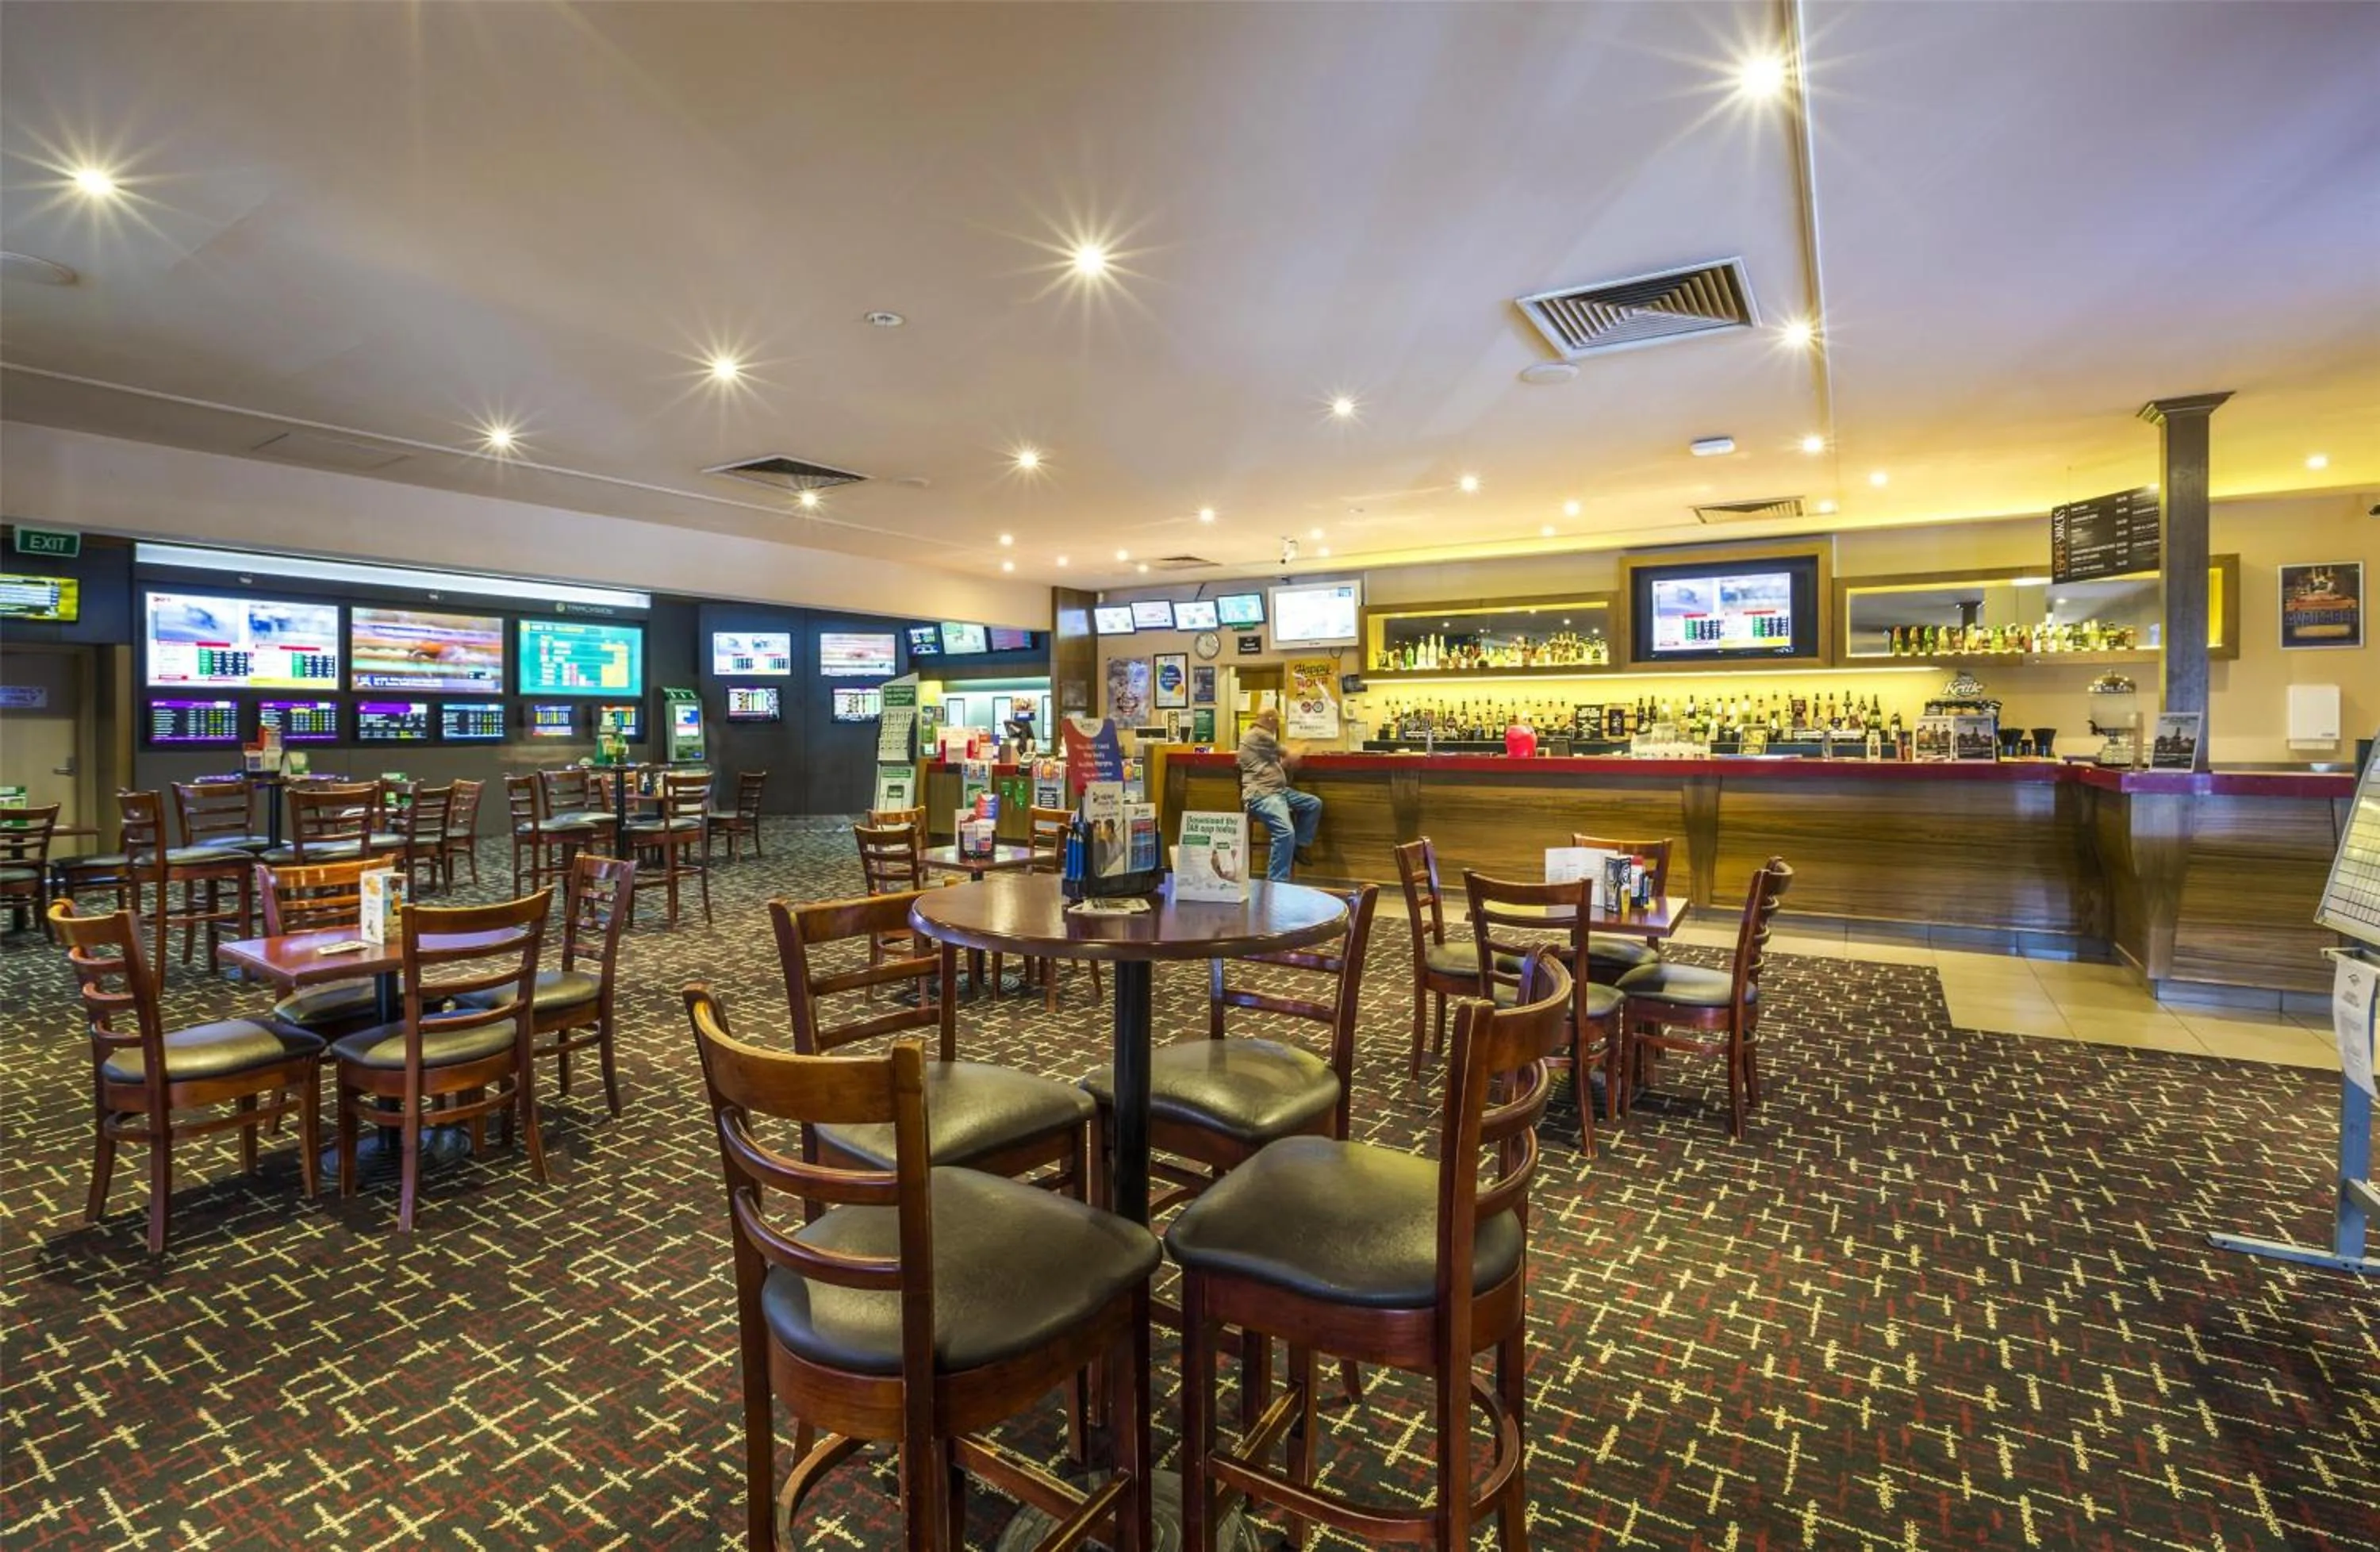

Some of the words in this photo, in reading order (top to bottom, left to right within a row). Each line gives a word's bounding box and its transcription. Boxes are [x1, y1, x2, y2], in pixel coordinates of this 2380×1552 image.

[2054, 508, 2066, 544] SNACKS
[29, 534, 67, 551] EXIT
[2055, 544, 2066, 573] BAR
[1294, 663, 1331, 676] Happy
[1942, 682, 1984, 696] Kettle
[1187, 816, 1224, 824] Download
[1215, 825, 1237, 835] today
